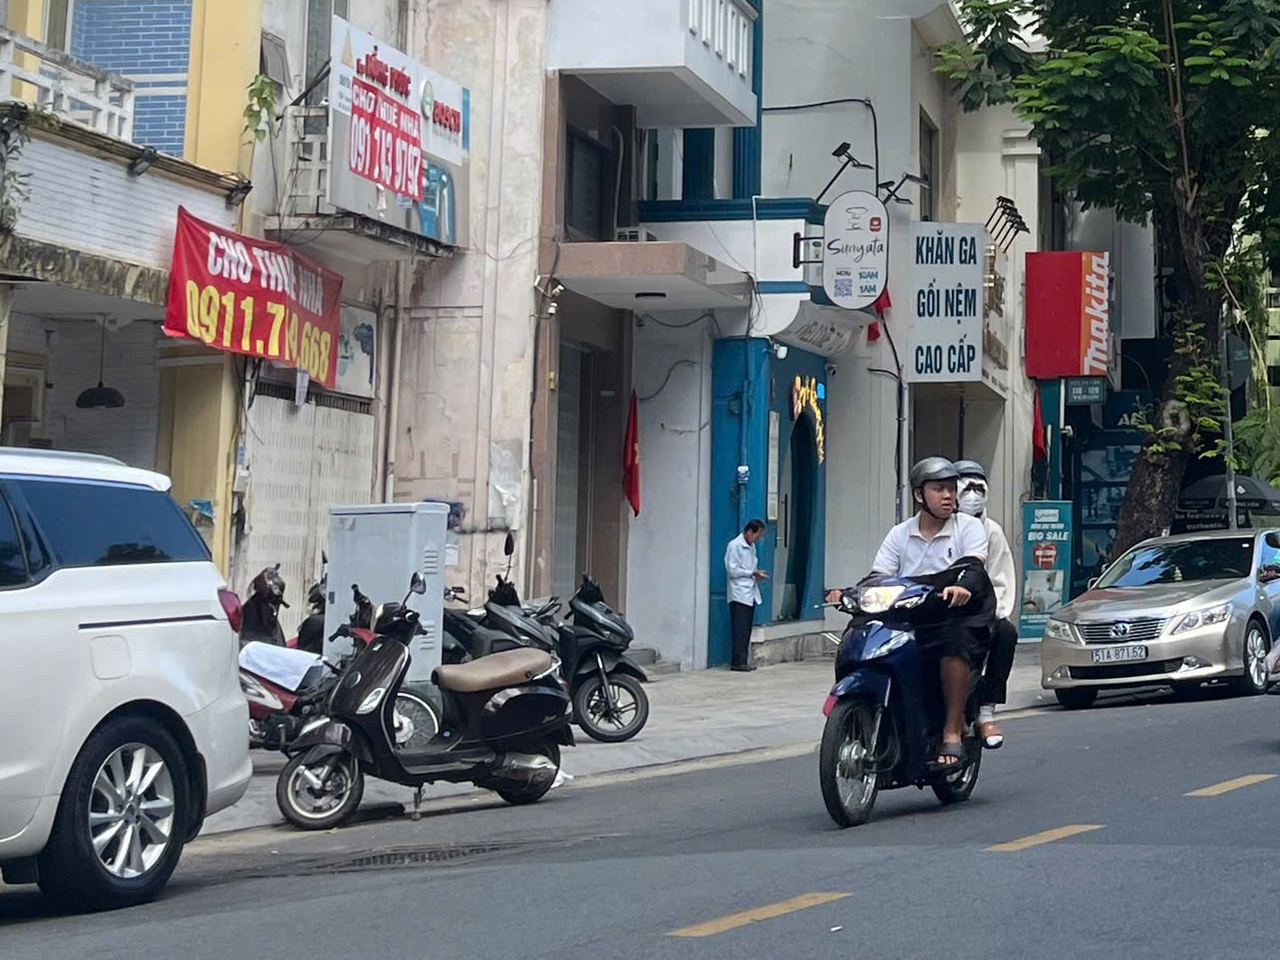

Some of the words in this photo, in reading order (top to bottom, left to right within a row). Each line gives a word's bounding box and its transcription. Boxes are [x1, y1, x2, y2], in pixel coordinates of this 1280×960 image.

[352, 83, 376, 114] CHO
[207, 231, 253, 284] CHO
[826, 237, 885, 263] Sunyata
[915, 230, 955, 265] KHĂN
[958, 236, 978, 265] GA
[858, 270, 879, 280] 10AM
[859, 284, 877, 294] 1AM
[916, 278, 941, 318] GỐI
[944, 282, 977, 325] NỆM
[914, 345, 943, 375] CAO
[947, 334, 976, 374] CẤP
[1028, 531, 1045, 541] BIG
[1046, 531, 1070, 541] SALE
